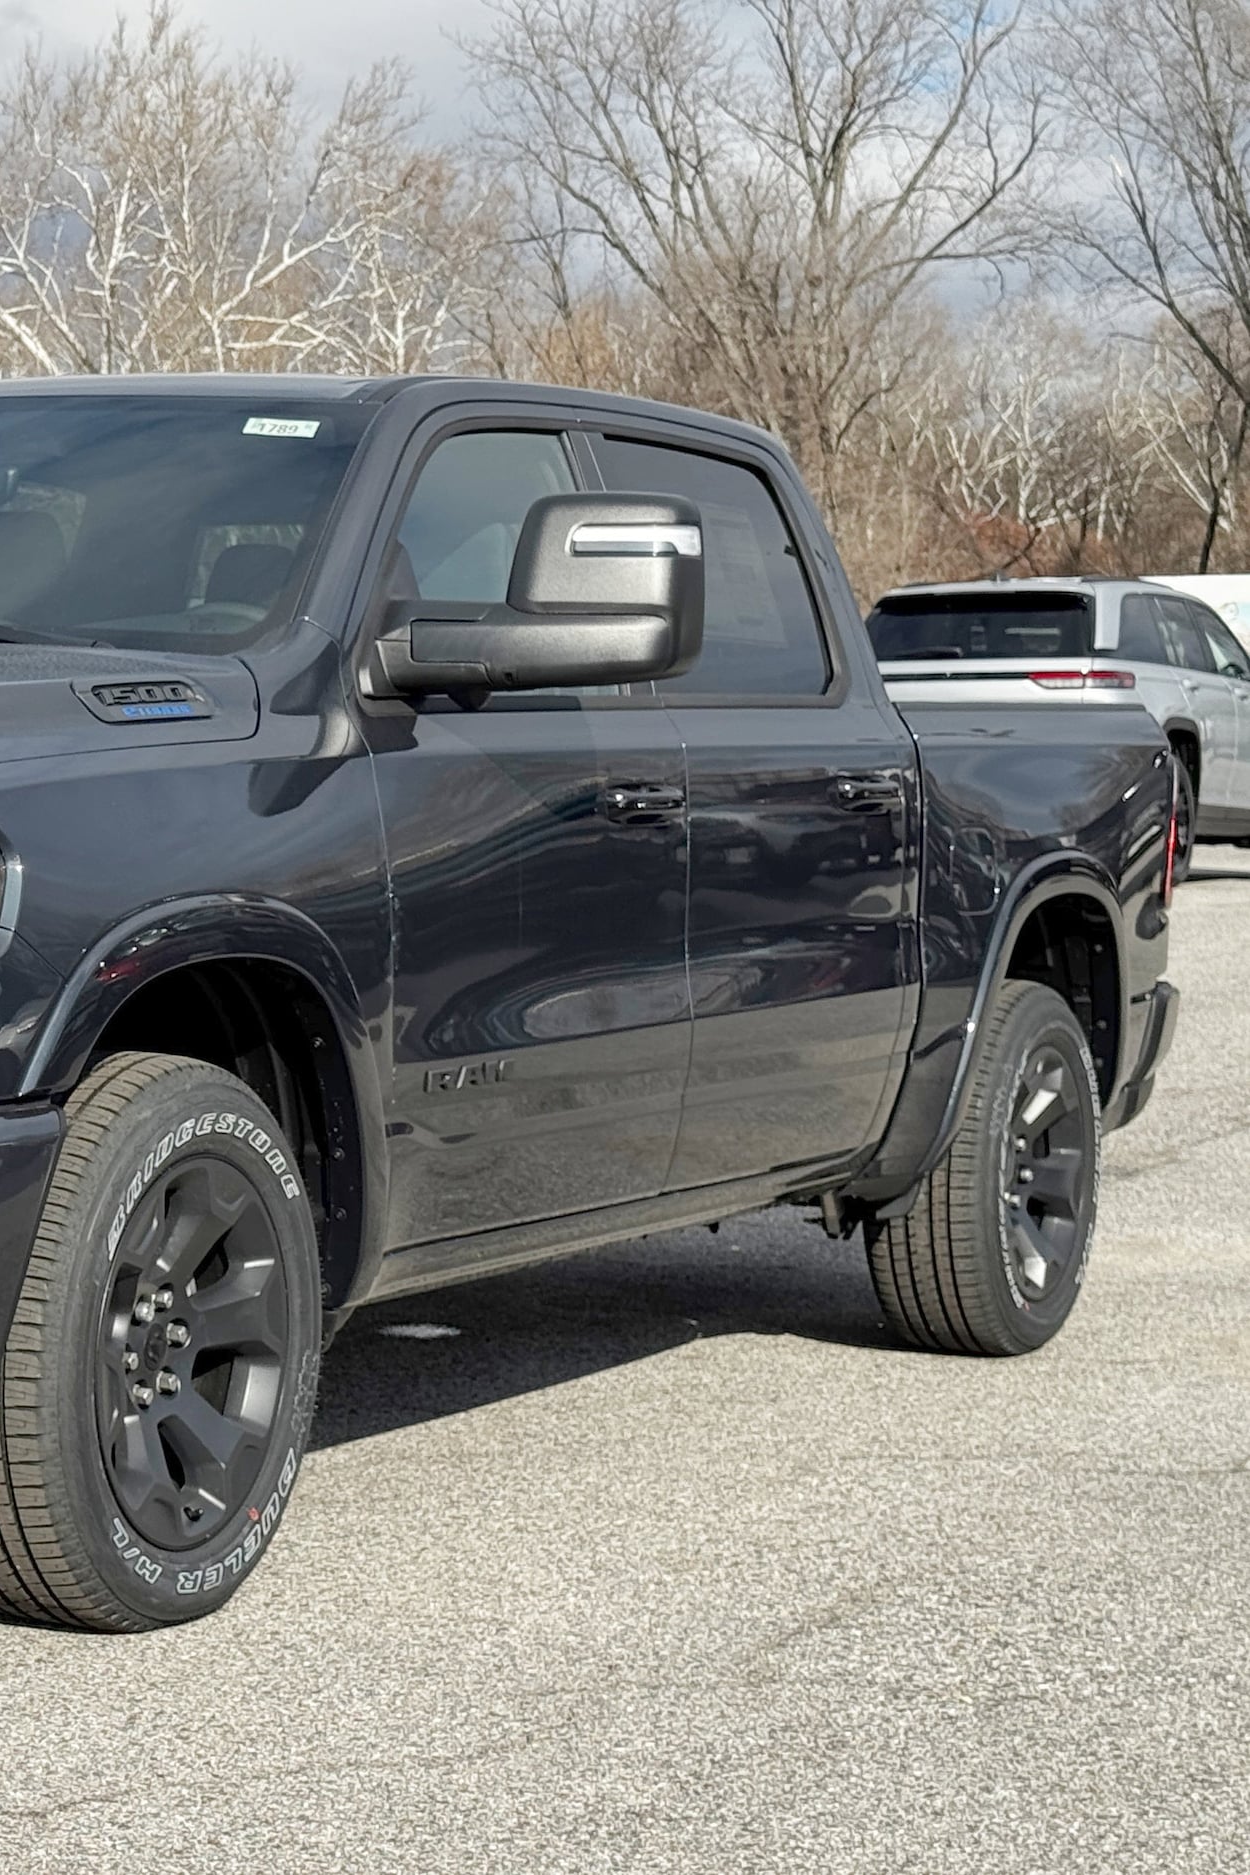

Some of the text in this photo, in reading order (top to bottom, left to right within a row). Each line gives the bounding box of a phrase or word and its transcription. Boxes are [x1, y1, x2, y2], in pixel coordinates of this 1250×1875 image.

[93, 684, 190, 706] 1500
[107, 1112, 301, 1262] BRIDGESTONE
[175, 1447, 298, 1594] DUELER
